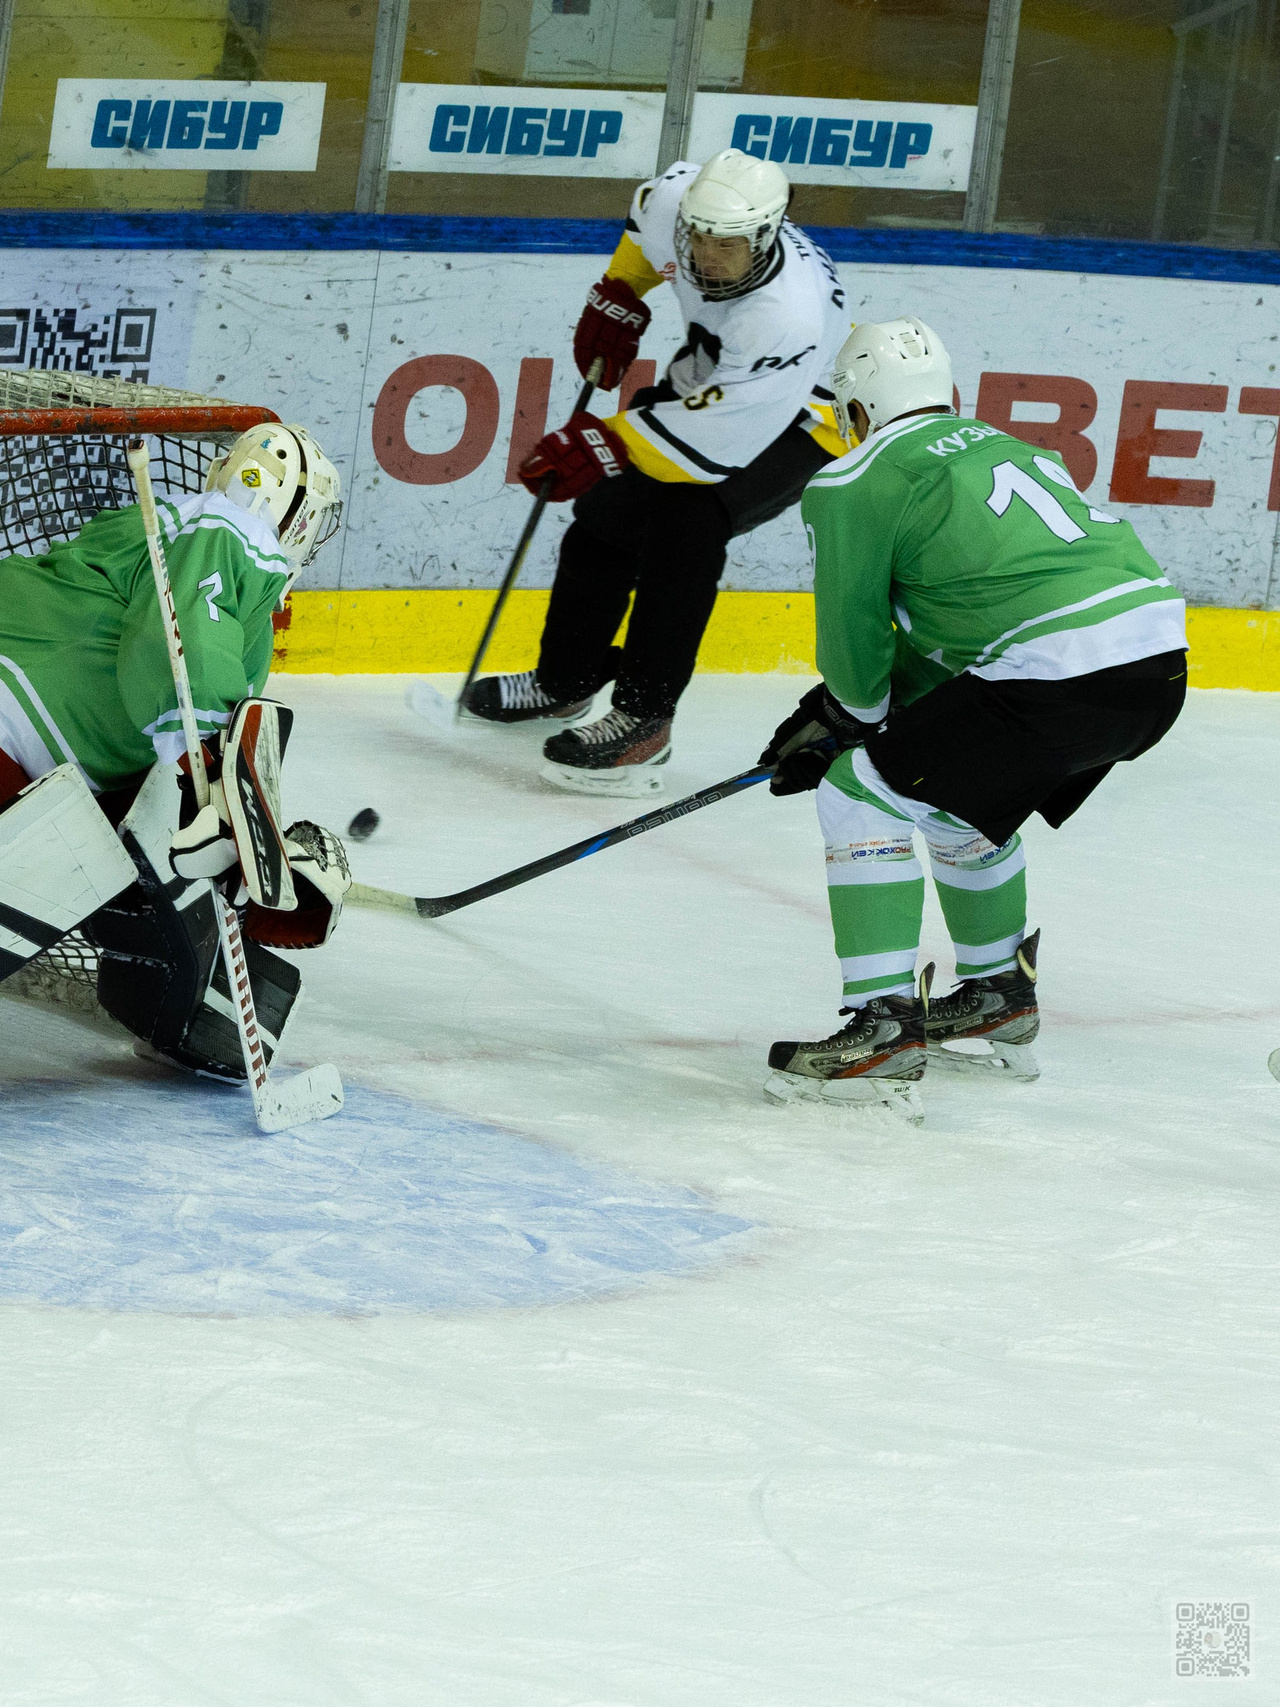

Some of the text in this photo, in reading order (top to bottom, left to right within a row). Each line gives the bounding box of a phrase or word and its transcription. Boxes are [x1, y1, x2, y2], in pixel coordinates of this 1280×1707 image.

[91, 99, 283, 150] СИБУР
[429, 104, 623, 157] СИБУР
[731, 114, 932, 168] СИБУР
[580, 428, 623, 478] BAU
[221, 902, 268, 1092] ARRIOR
